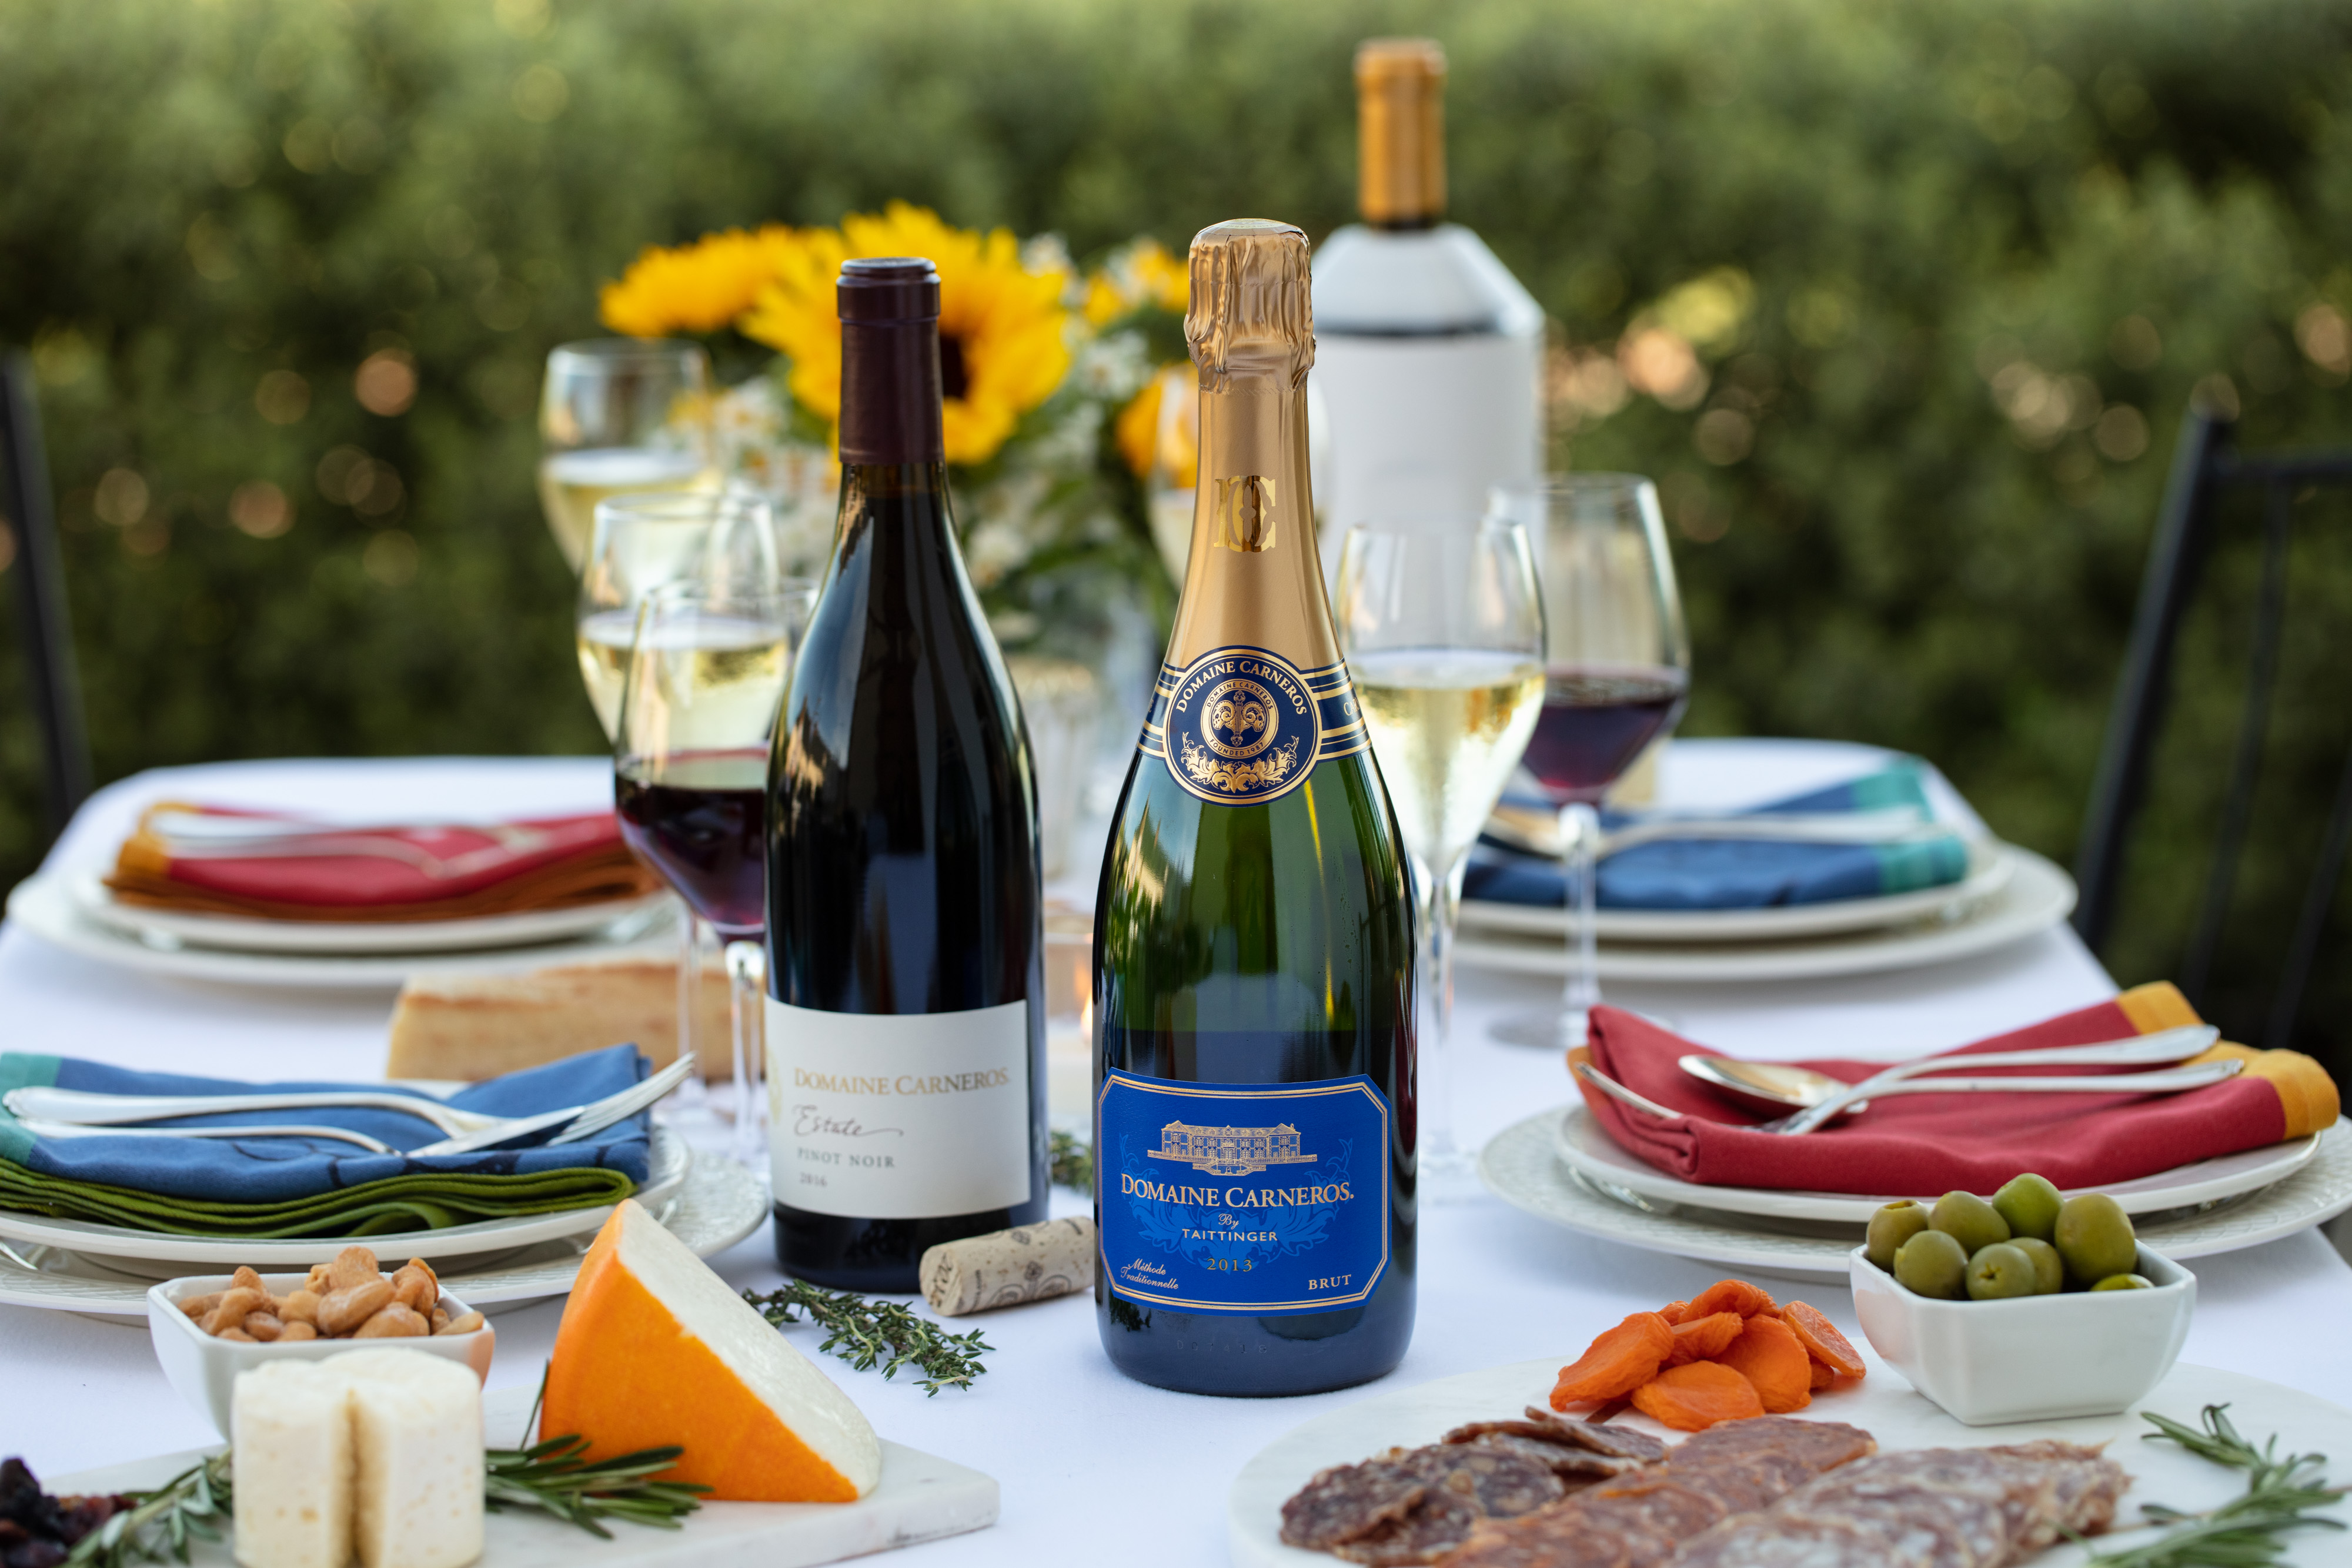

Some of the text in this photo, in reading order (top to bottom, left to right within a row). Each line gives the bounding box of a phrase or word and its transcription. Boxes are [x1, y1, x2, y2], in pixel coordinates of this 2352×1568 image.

[1176, 661, 1307, 715] DOMAINE CARNEROS
[1207, 682, 1274, 710] DOMAINE CARNEROS
[1210, 739, 1264, 756] FOUNDED 1987
[794, 1068, 890, 1095] DOMAINE
[792, 1104, 904, 1137] Estate
[797, 1148, 896, 1168] PINOT NOIR
[1121, 1173, 1220, 1206] DOMAINE
[1218, 1213, 1239, 1230] By
[1182, 1229, 1277, 1241] TAITTINGER
[1128, 1258, 1167, 1275] Méthode
[1207, 1258, 1252, 1272] 2013
[1120, 1266, 1179, 1289] Traditionnelle
[1308, 1274, 1352, 1290] BRUT
